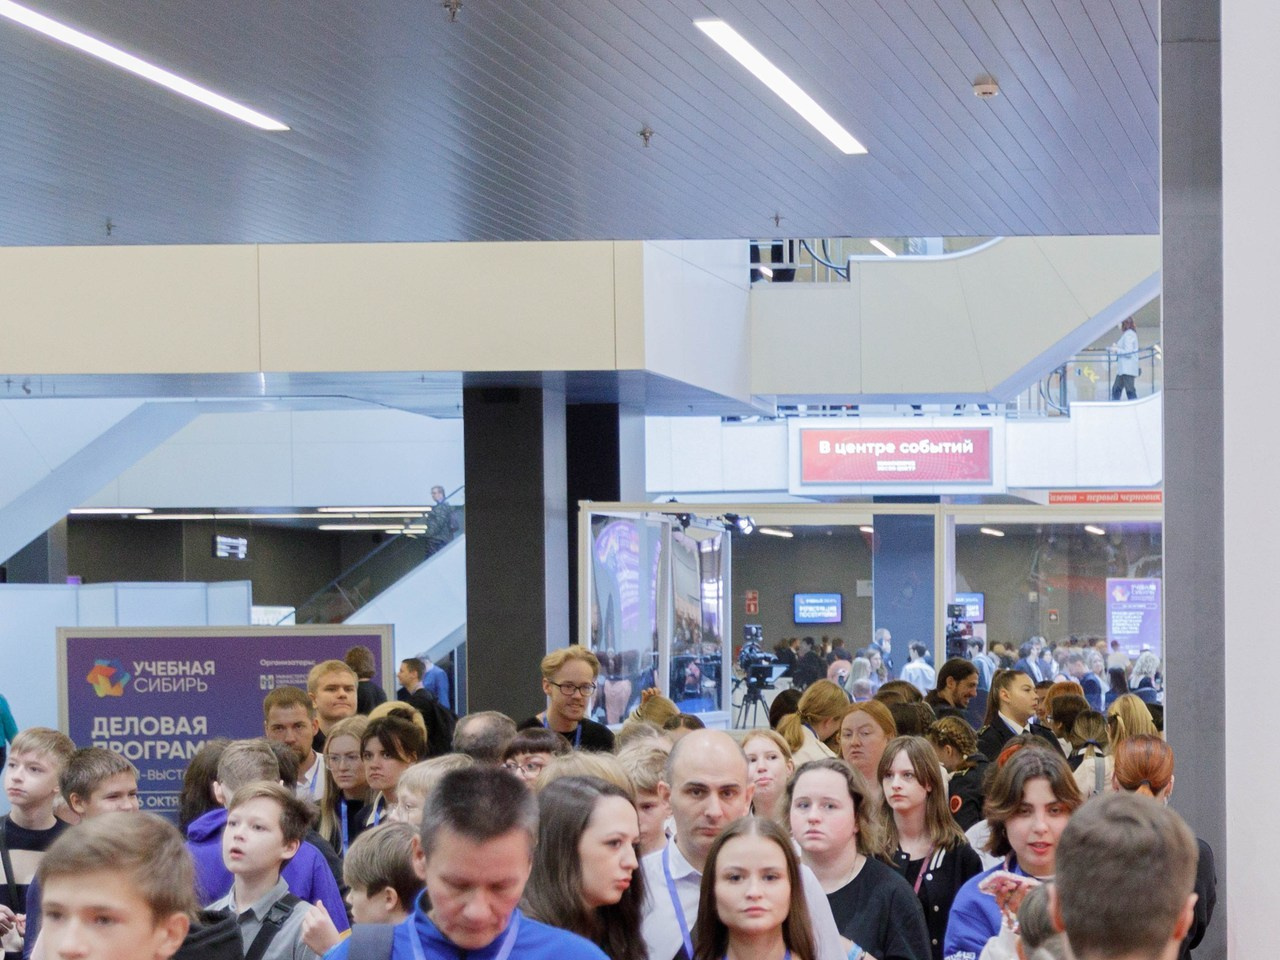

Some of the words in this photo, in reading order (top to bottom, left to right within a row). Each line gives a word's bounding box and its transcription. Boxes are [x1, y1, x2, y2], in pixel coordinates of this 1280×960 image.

[818, 441, 831, 454] В
[835, 441, 896, 457] центре
[899, 439, 974, 454] событий
[1086, 493, 1119, 503] первый
[1120, 493, 1161, 503] черновик
[133, 660, 216, 676] УЧЕБНАЯ
[133, 677, 208, 694] СИБИРЬ
[91, 716, 208, 739] ДЕЛОВАЯ
[92, 740, 206, 760] РОГРАМ
